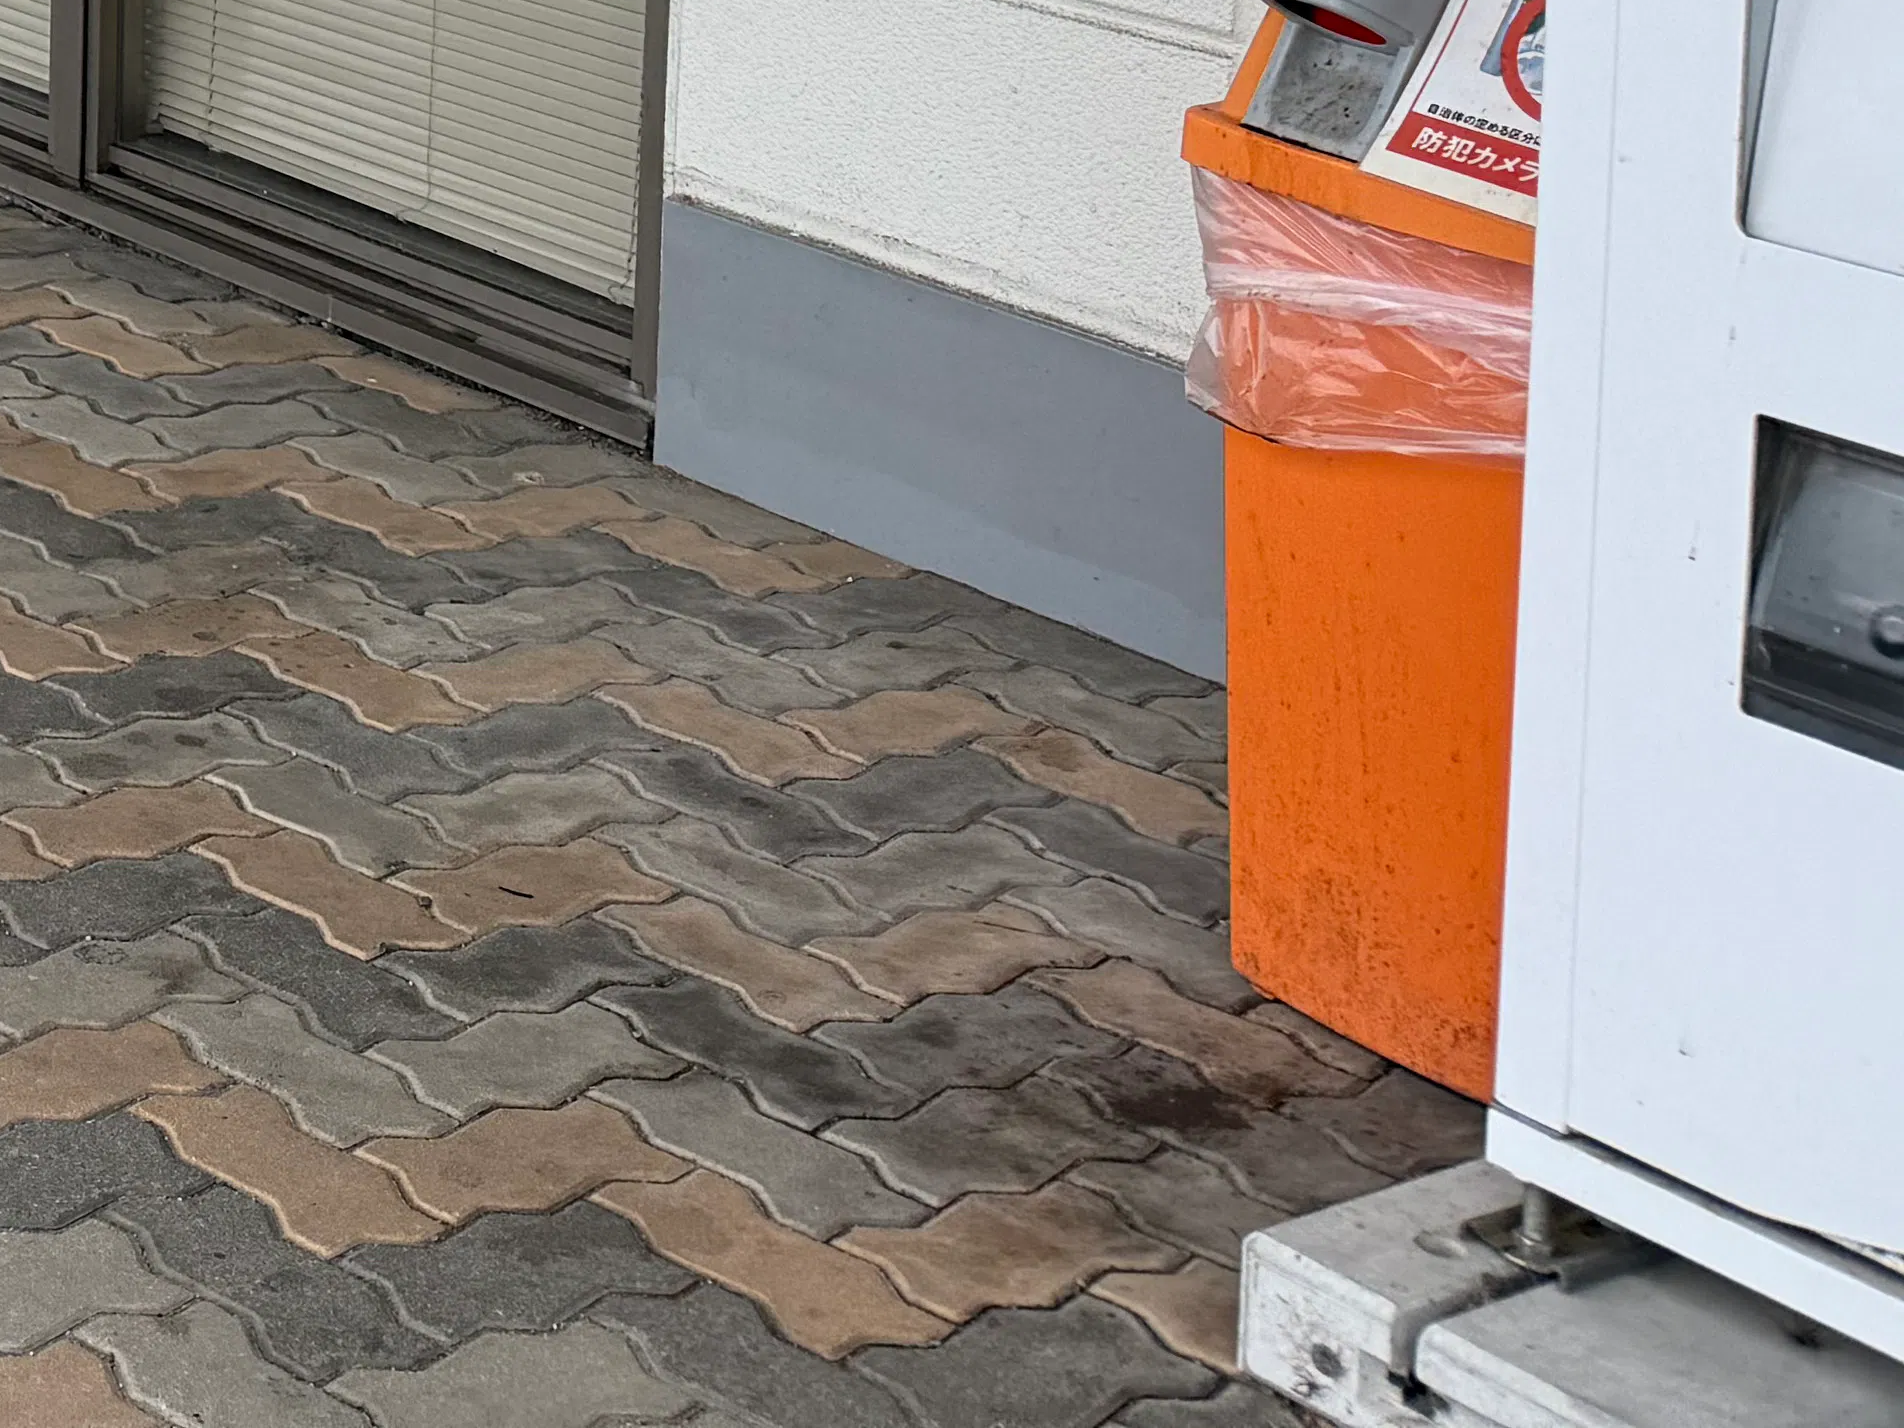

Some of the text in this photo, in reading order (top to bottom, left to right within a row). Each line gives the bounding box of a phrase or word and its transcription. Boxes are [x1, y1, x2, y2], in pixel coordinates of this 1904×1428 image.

[1411, 126, 1540, 182] 防犯カメラ
